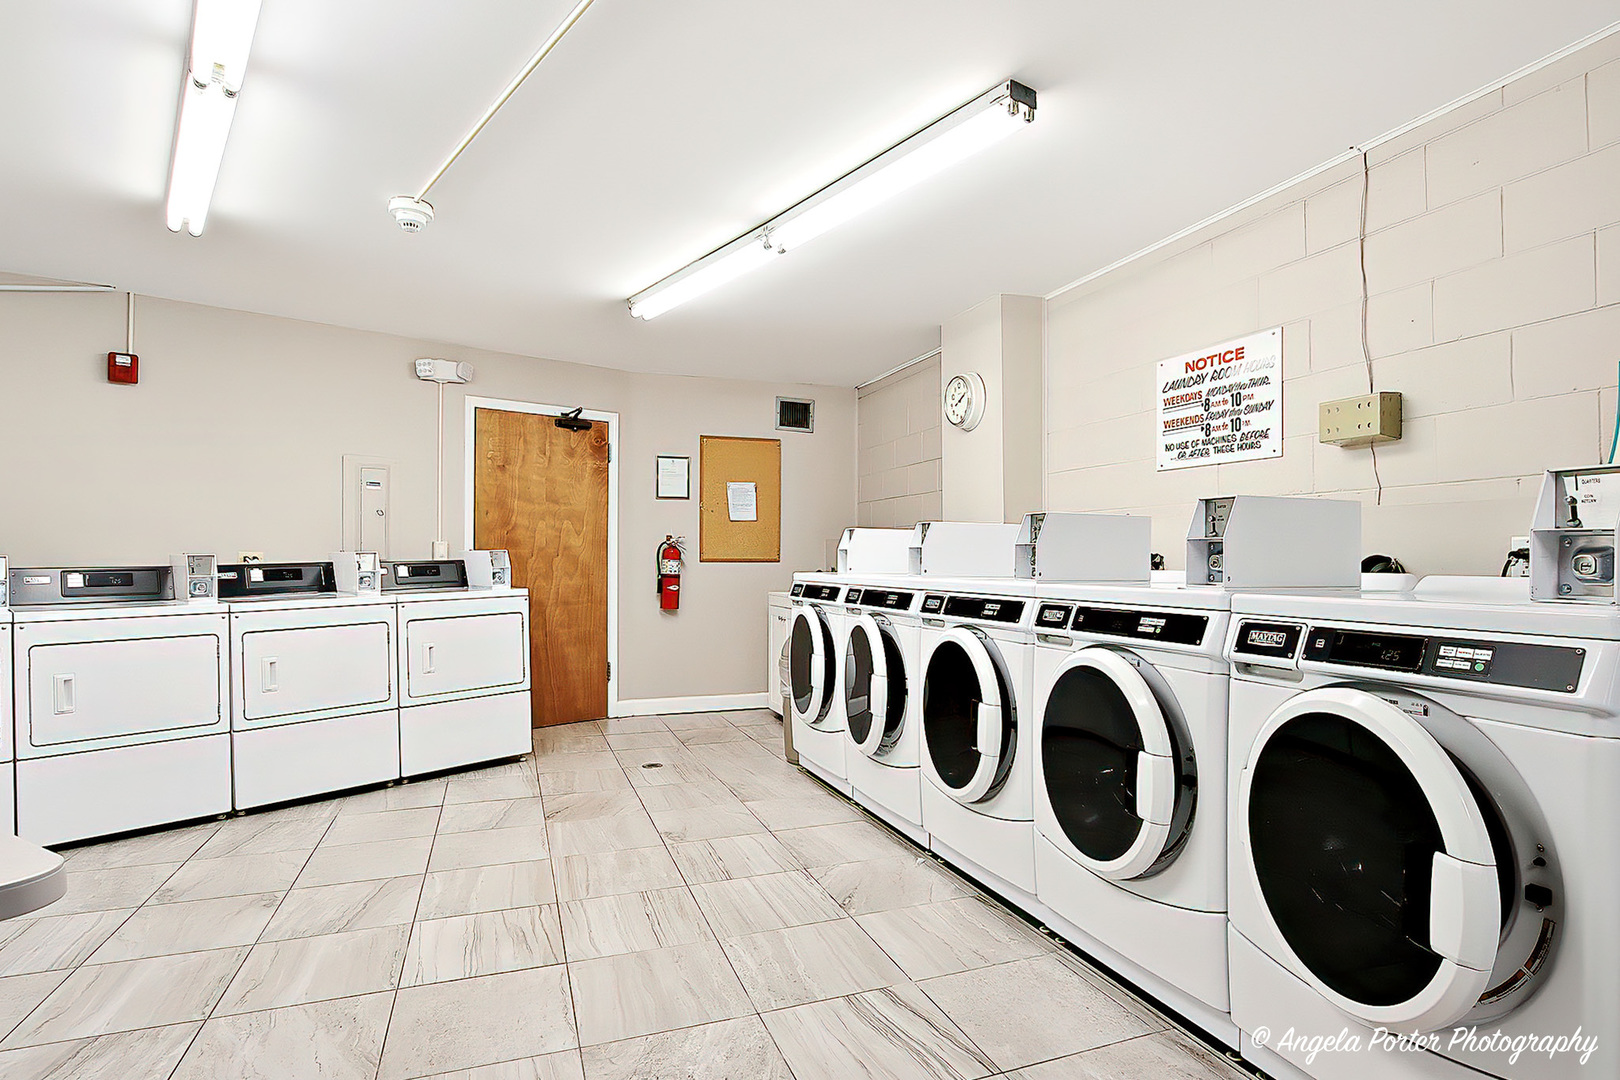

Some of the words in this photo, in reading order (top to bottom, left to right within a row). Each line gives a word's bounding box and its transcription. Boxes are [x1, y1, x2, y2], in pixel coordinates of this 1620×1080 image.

[1184, 346, 1245, 374] NOTICE
[1162, 372, 1209, 394] LAUNDRY
[1210, 363, 1242, 382] ROOM
[1243, 355, 1276, 373] HOURS
[1163, 390, 1202, 407] WEEKDAYS
[1205, 382, 1236, 398] MONDAY
[1204, 397, 1210, 412] 8
[1230, 391, 1241, 407] 10
[1242, 393, 1254, 401] PM
[1163, 413, 1204, 429] WEEKENDS
[1205, 408, 1231, 422] FRIDAY
[1243, 399, 1275, 415] SUNDAY
[1205, 422, 1211, 437] 8
[1212, 424, 1221, 432] AM
[1230, 416, 1241, 433] 10
[1165, 443, 1175, 452] NO
[1176, 440, 1190, 450] USE
[1191, 438, 1200, 449] OF
[1201, 433, 1237, 446] MACHINES
[1240, 427, 1270, 442] BEFORE
[1188, 447, 1211, 459] AFTER
[1212, 443, 1235, 454] THESE
[1236, 440, 1262, 452] HOURS
[1251, 632, 1284, 643] MAYTAG
